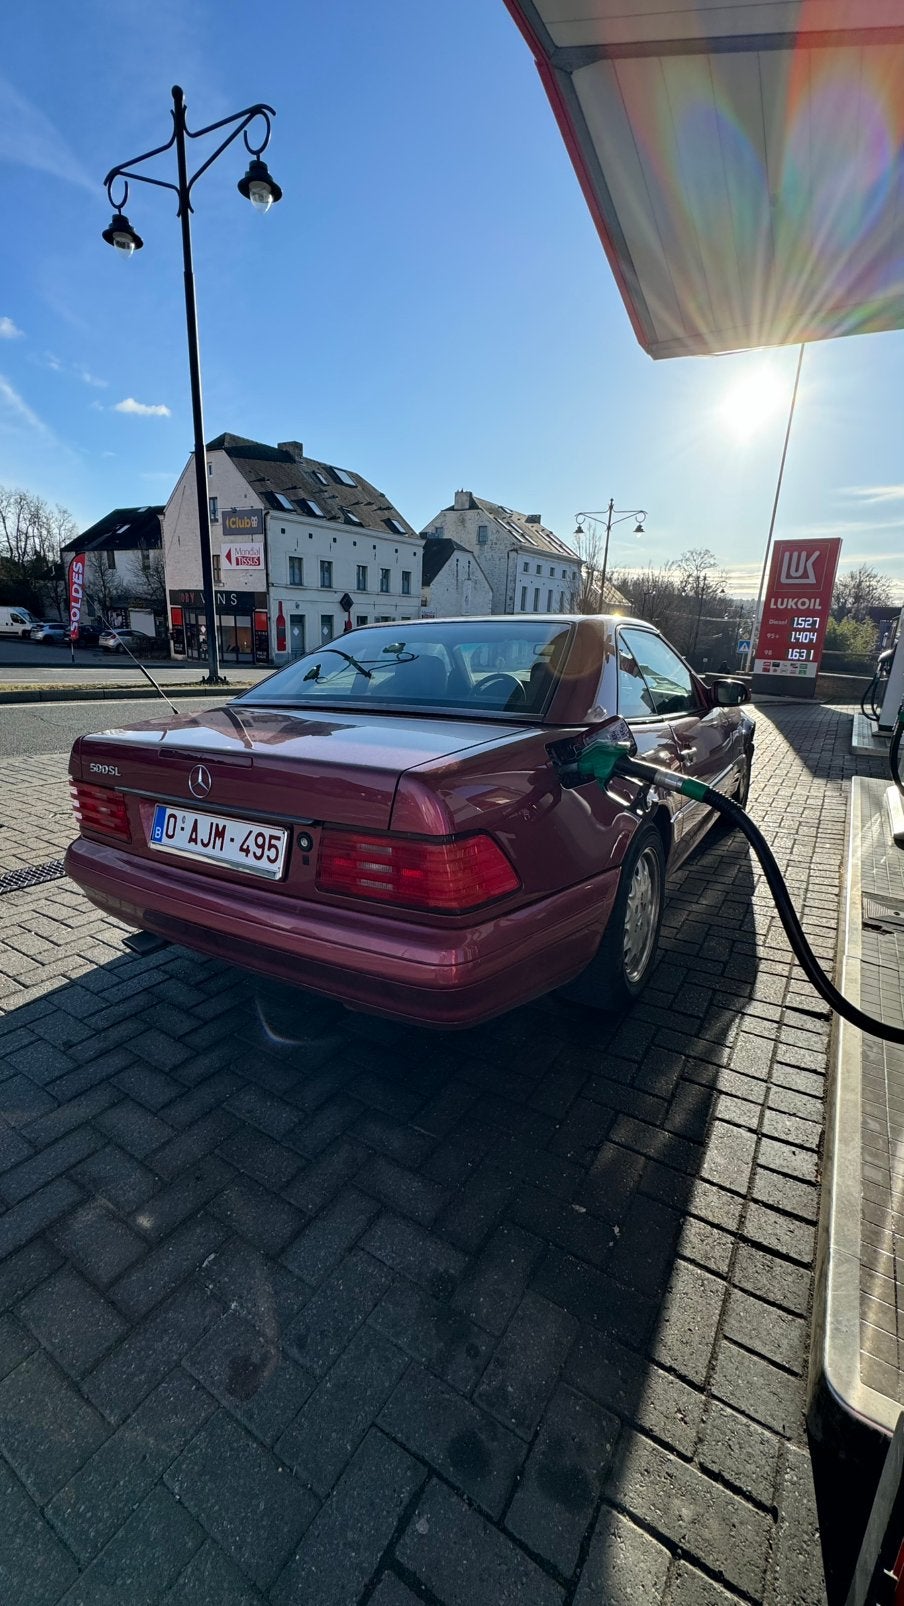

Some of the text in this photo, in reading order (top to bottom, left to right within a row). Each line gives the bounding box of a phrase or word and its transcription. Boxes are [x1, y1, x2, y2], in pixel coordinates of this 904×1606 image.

[70, 561, 83, 631] SOLDES
[770, 597, 822, 610] LUKOIL
[154, 826, 162, 839] B
